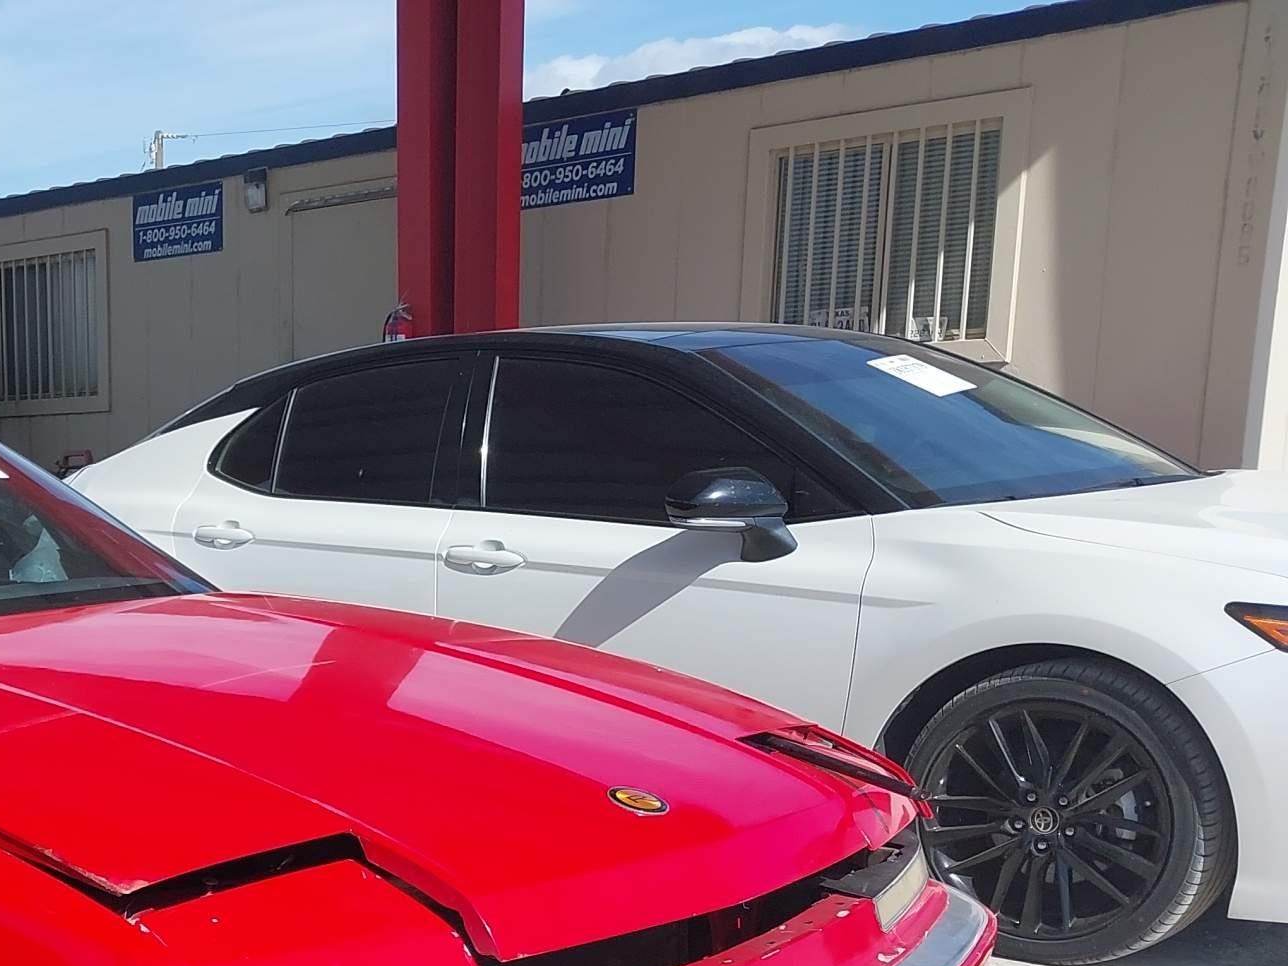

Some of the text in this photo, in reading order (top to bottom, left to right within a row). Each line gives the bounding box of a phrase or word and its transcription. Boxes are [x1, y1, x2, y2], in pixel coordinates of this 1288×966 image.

[579, 118, 632, 155] mini
[522, 158, 624, 188] 800-950-6464
[135, 189, 219, 225] mobile mini
[139, 221, 216, 244] 1-800-950-6464
[144, 240, 212, 258] mobilemini.com
